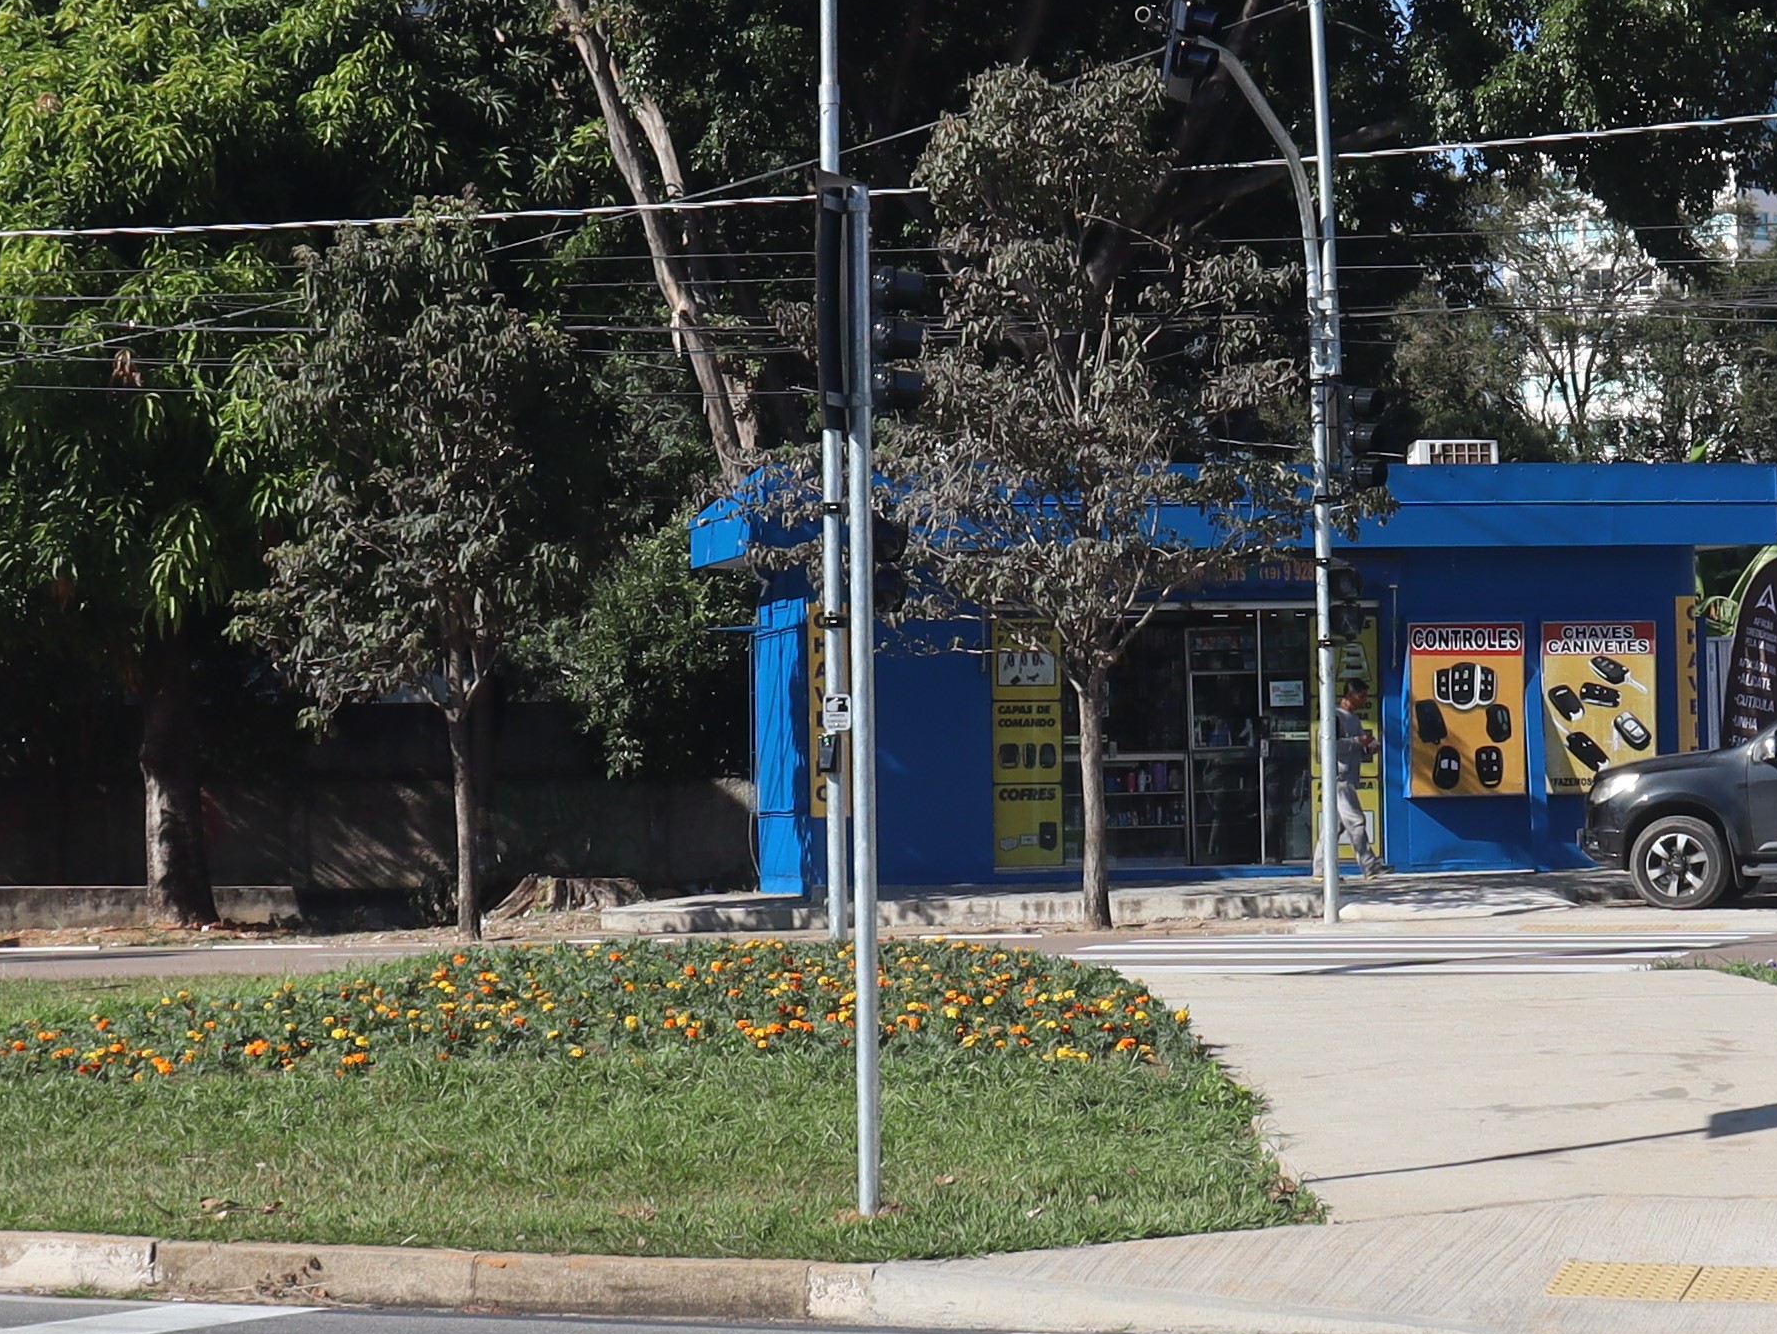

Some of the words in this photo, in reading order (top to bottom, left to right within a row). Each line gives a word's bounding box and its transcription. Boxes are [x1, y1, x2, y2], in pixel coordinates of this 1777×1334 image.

[1412, 628, 1521, 650] CONTROLES
[1562, 626, 1634, 640] CHAVES
[1547, 640, 1650, 655] CANIVETES
[998, 705, 1033, 715] CAPAS
[1037, 705, 1051, 715] DE
[998, 718, 1056, 728] COMANDO
[999, 788, 1056, 801] COFRES
